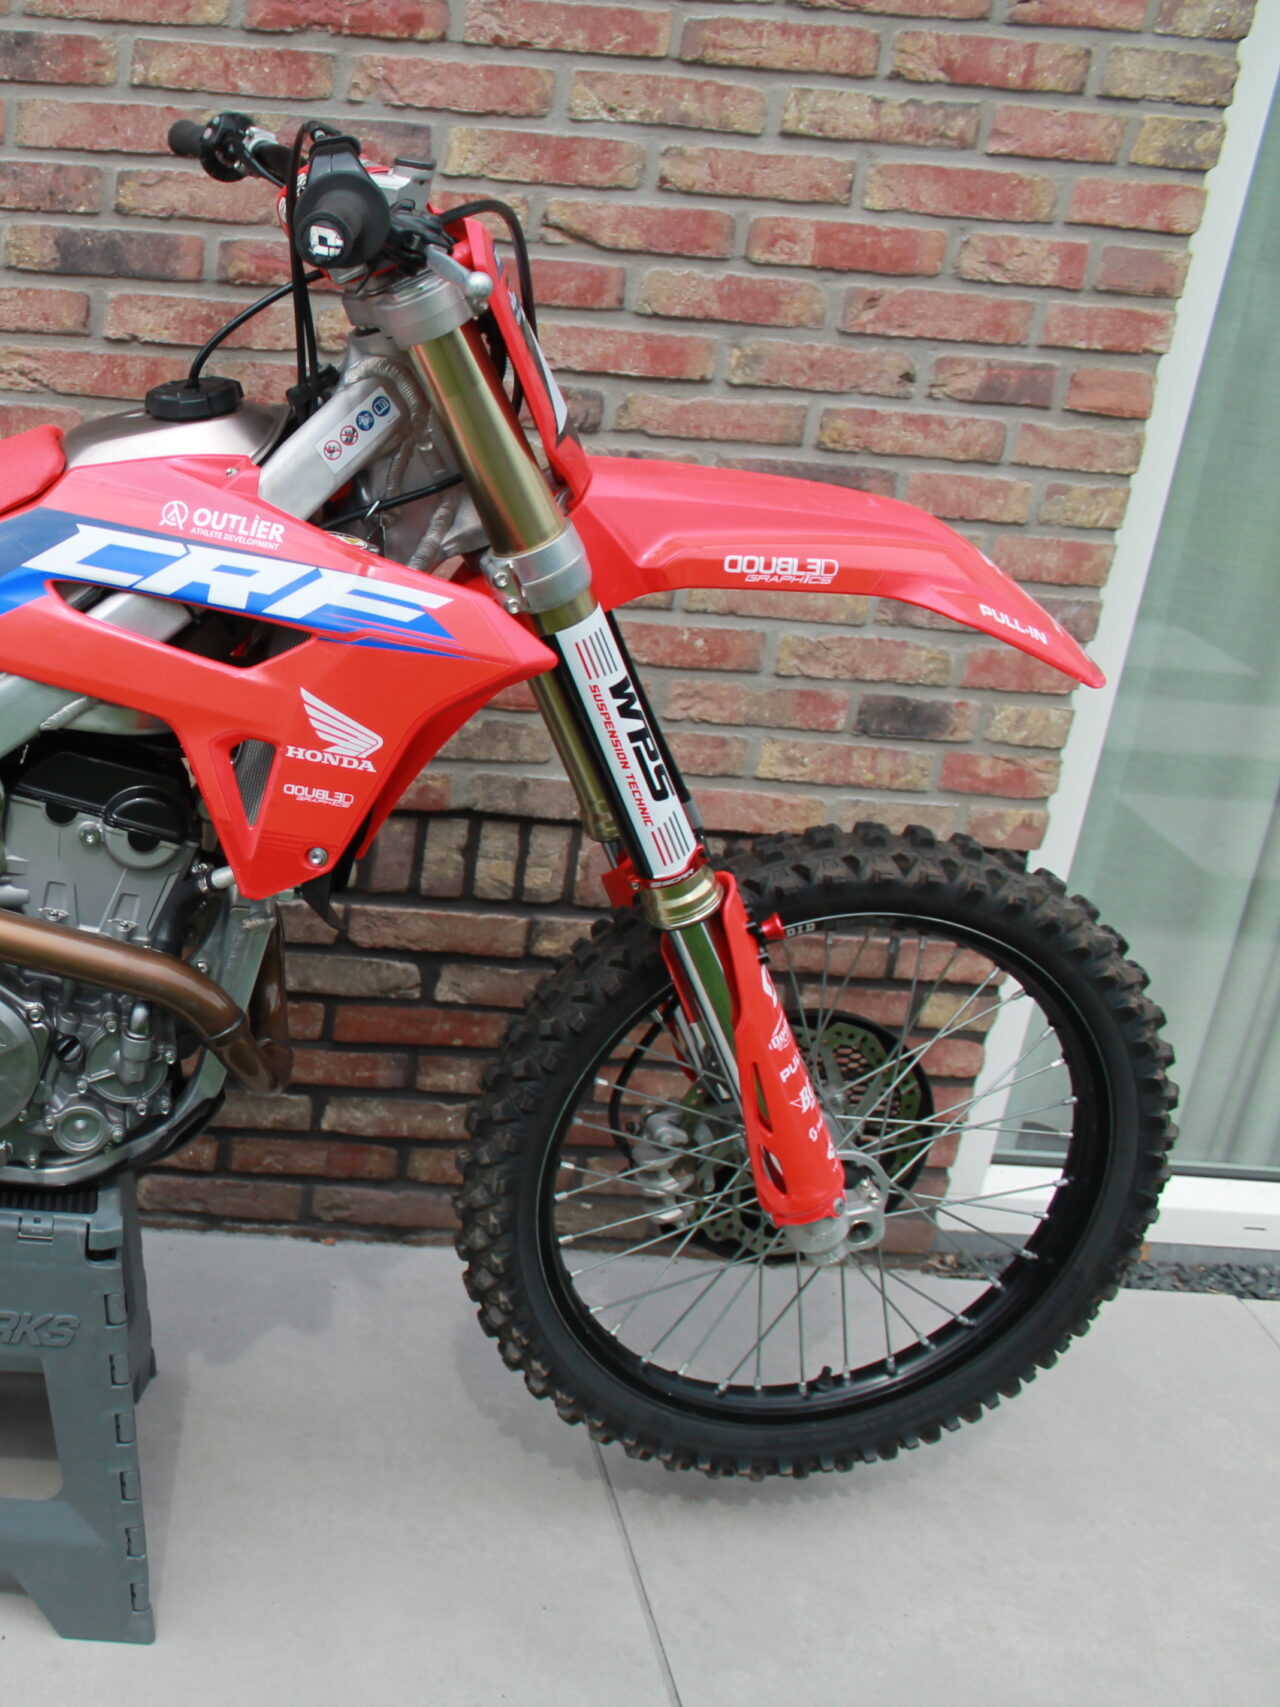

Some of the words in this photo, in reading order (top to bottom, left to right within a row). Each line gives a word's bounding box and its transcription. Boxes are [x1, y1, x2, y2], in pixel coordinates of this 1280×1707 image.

[190, 526, 223, 540] ATHLETE
[223, 532, 280, 551] DEVELOPMENT
[192, 507, 285, 543] OUTLIER
[20, 523, 455, 623] CRF
[745, 574, 834, 585] GRAPHICS
[979, 603, 1048, 645] PULL-IN
[589, 684, 631, 770] SUSPENSION
[625, 773, 654, 827] TECHNIC
[609, 674, 676, 802] WPS
[285, 745, 377, 773] HONDA
